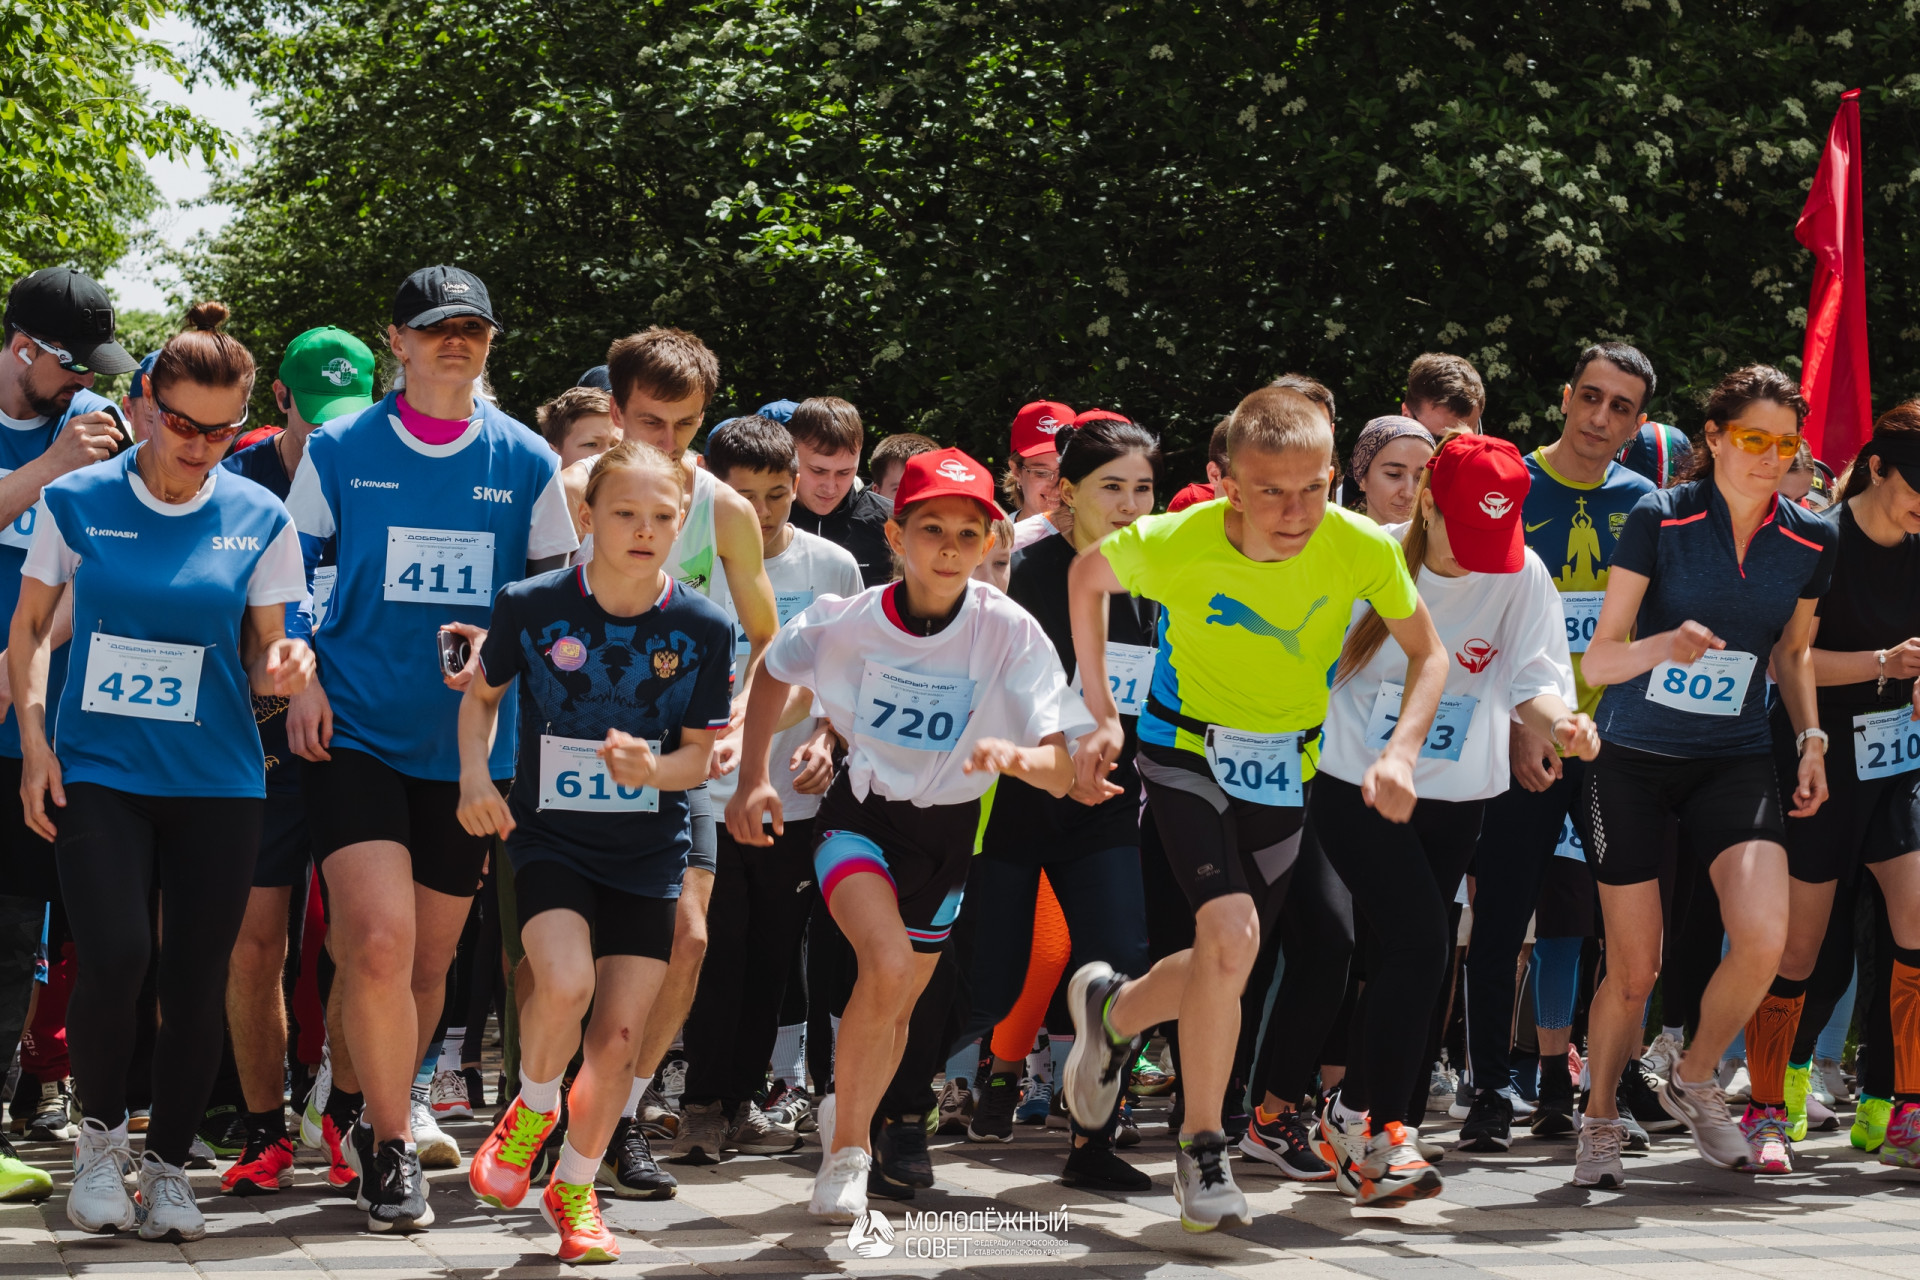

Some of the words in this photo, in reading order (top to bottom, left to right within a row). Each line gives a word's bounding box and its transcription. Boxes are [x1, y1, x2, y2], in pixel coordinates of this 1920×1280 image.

[362, 480, 399, 489] KINASH
[472, 486, 514, 504] SKVK
[98, 529, 138, 539] KINASH
[212, 536, 260, 551] SKVK
[398, 562, 477, 594] 411
[98, 671, 182, 707] 423
[1663, 668, 1736, 702] 802
[870, 698, 954, 741] 720
[1380, 713, 1455, 750] 73
[1867, 733, 1920, 769] 210
[1218, 757, 1290, 791] 204
